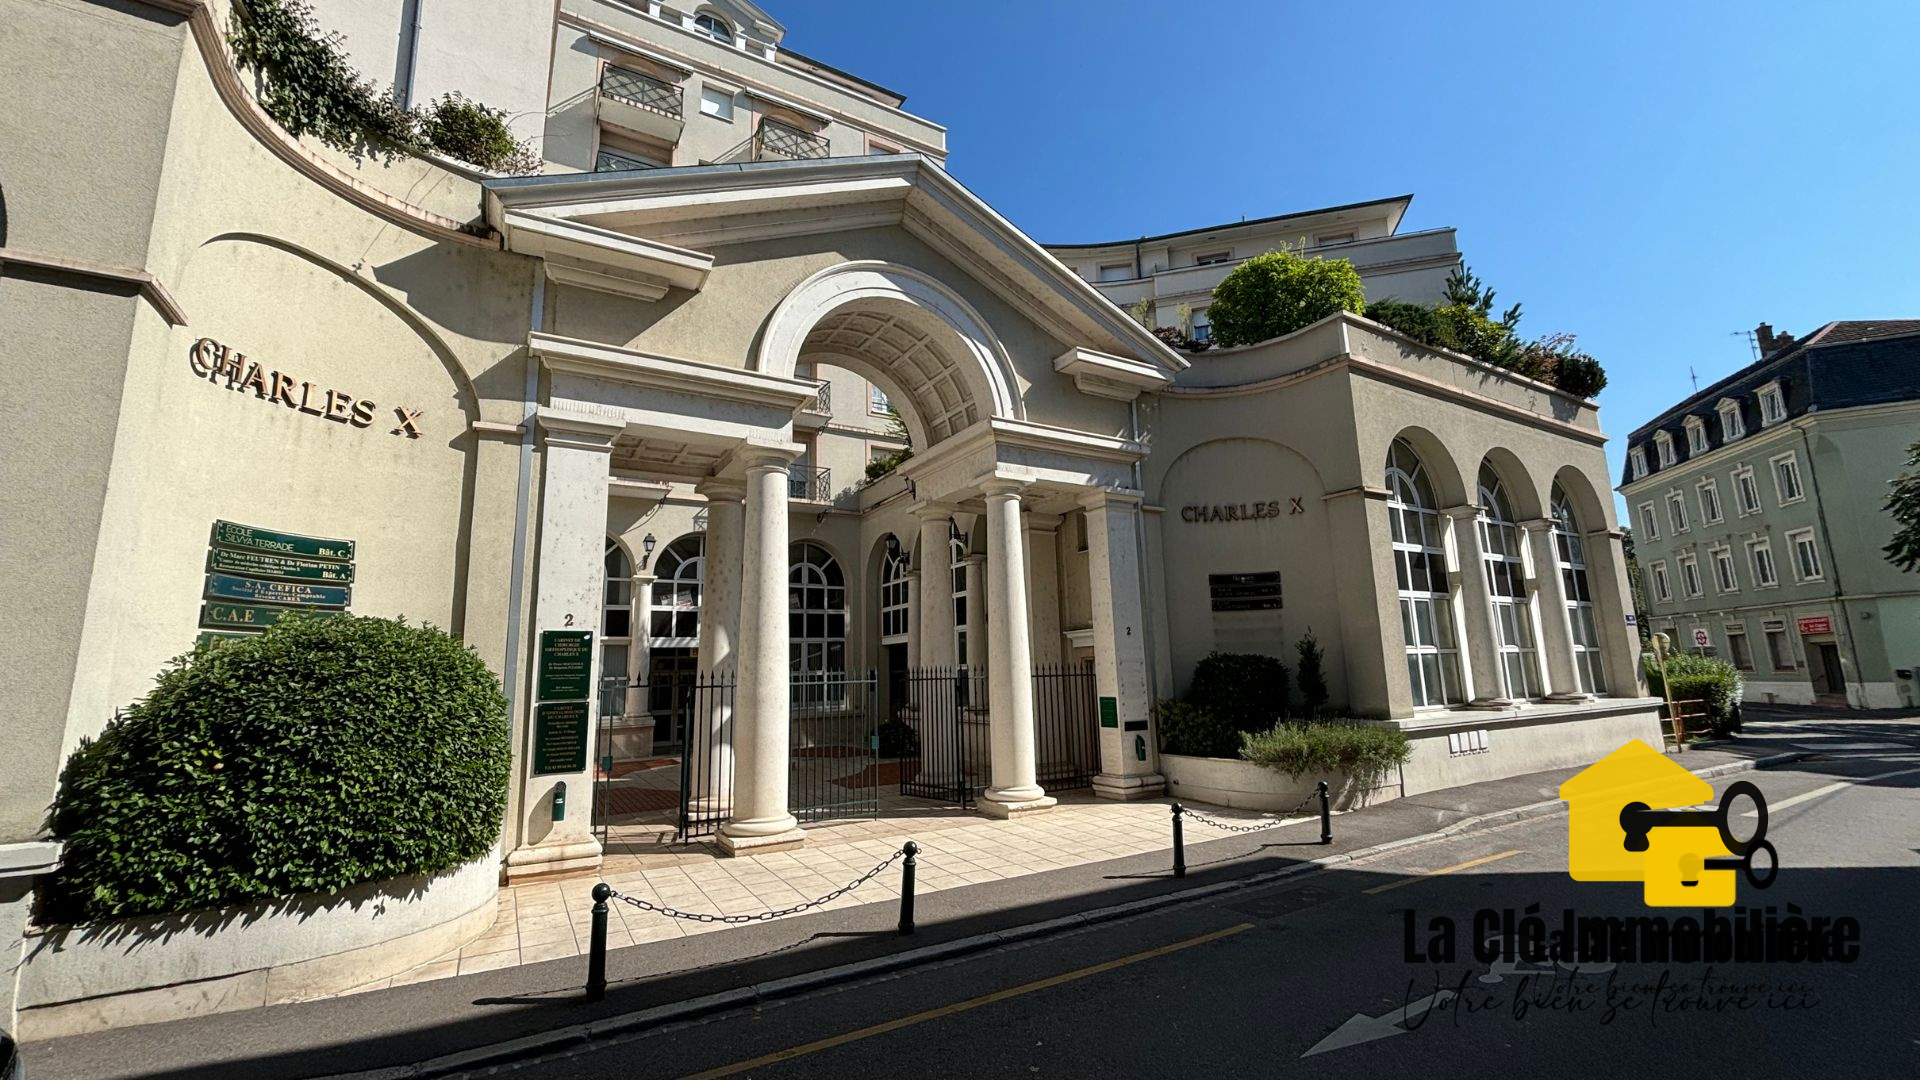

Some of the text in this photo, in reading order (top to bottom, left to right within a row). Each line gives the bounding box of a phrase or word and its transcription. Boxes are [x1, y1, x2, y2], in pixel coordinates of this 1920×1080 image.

[191, 336, 424, 439] CHARLES X
[1181, 496, 1305, 523] CHARLES X
[226, 525, 253, 537] ECOLE
[225, 533, 295, 552] SILVYA TERRADE
[337, 549, 346, 557] C
[245, 581, 312, 594] S.A. CEFICA
[564, 613, 574, 627] 2
[1126, 626, 1132, 635] 2
